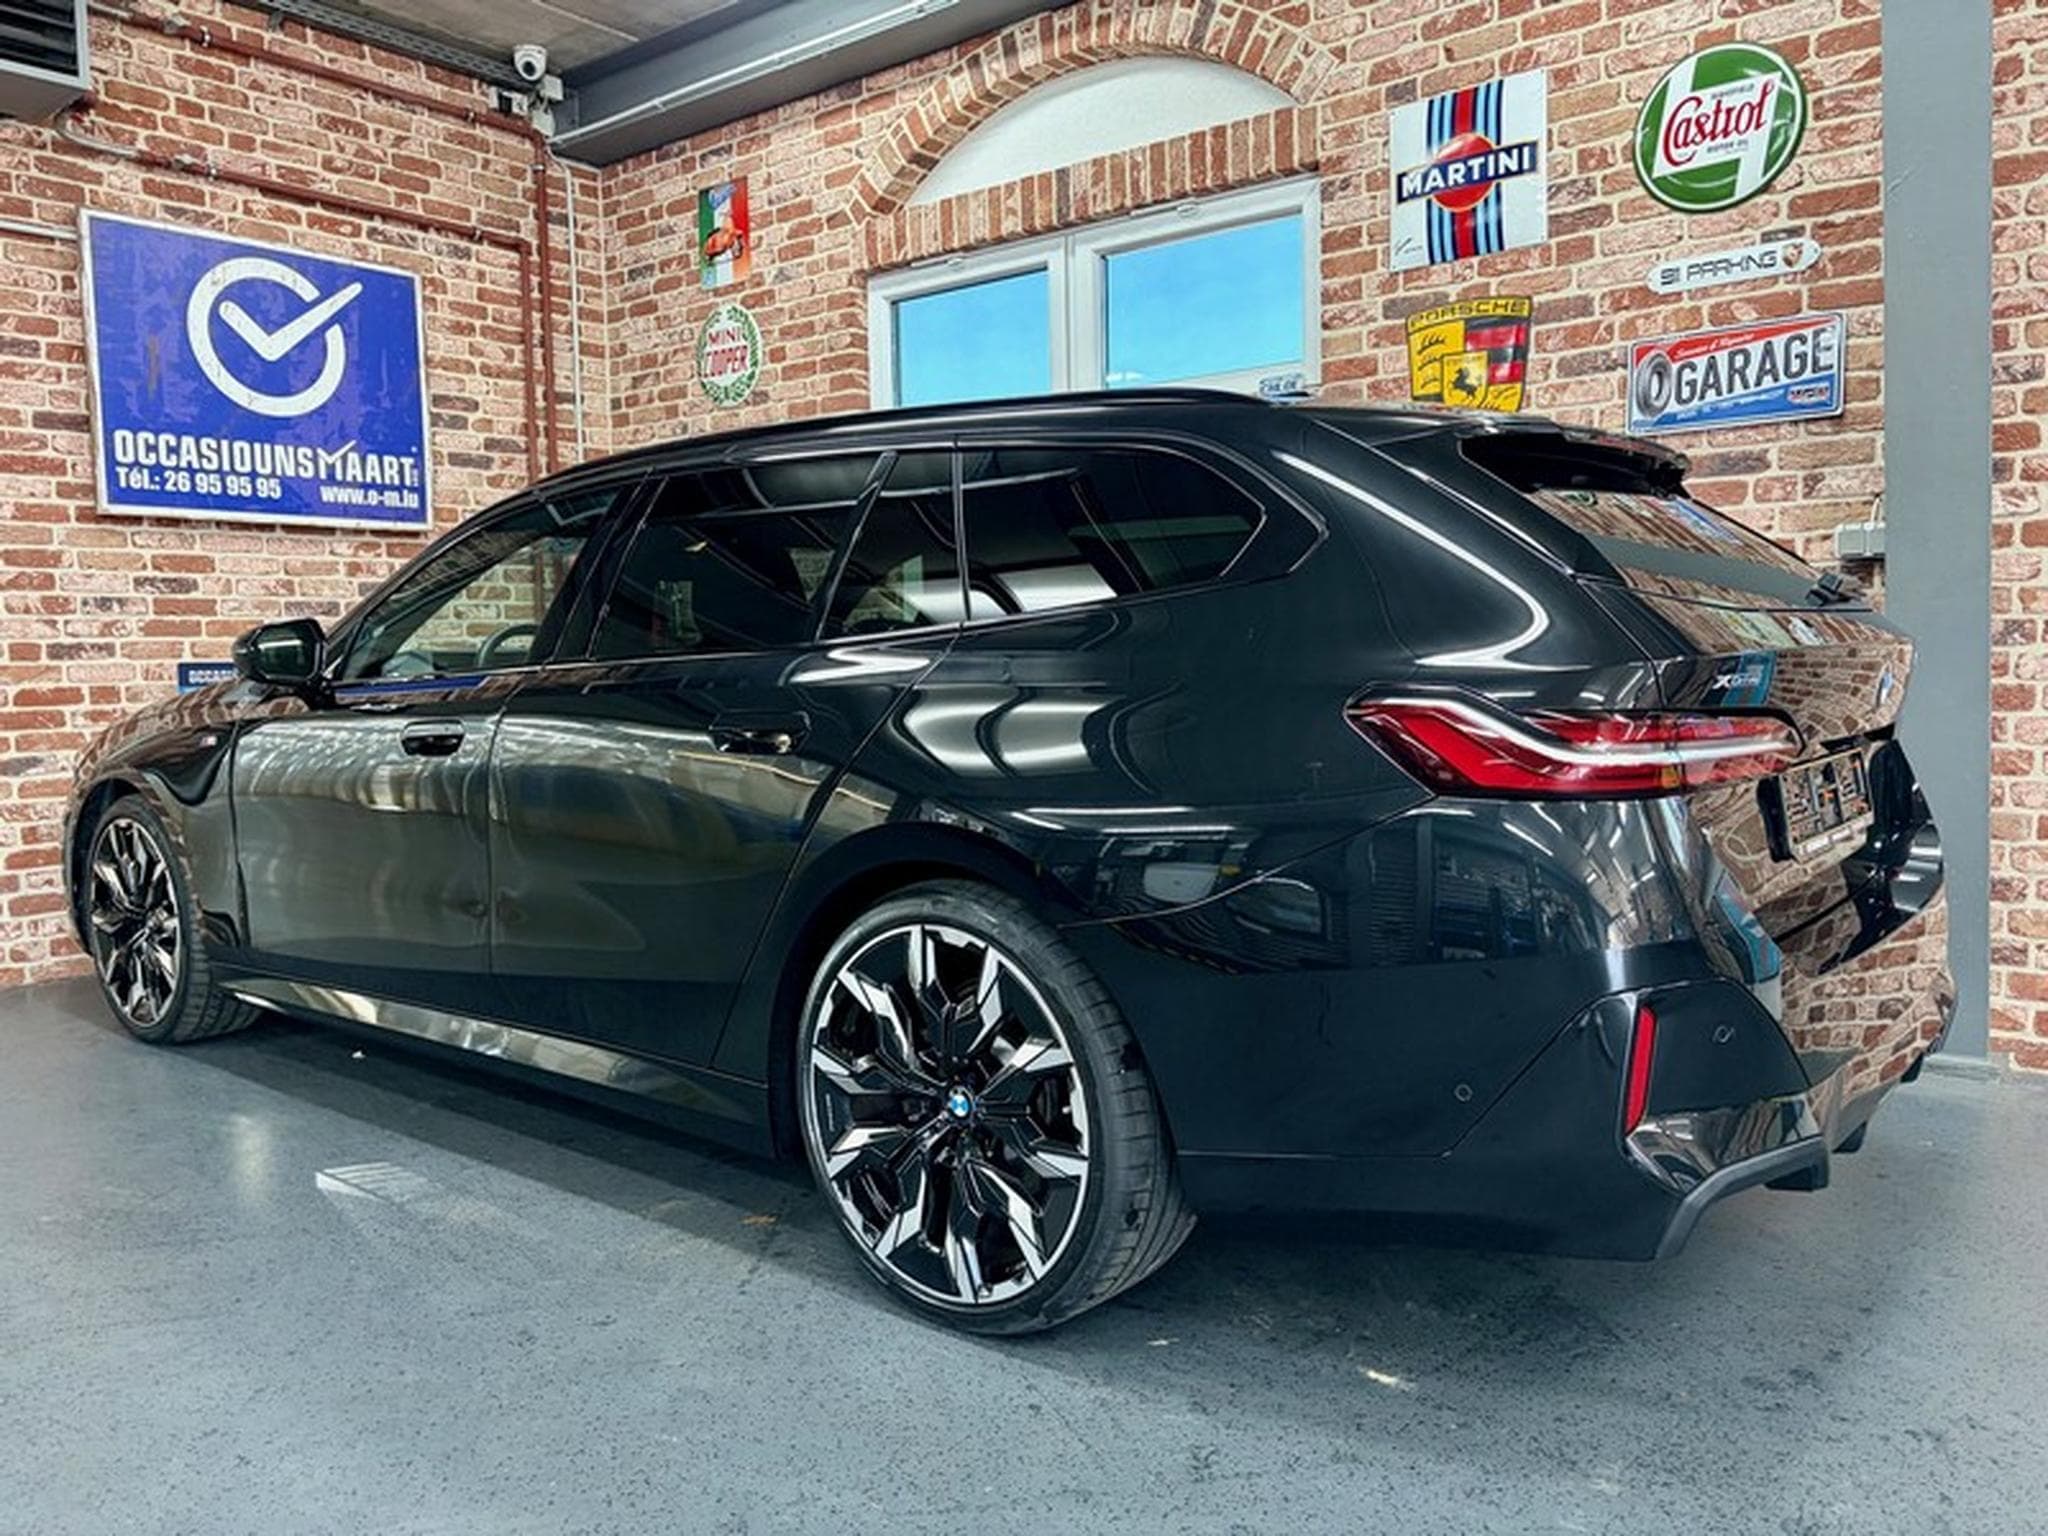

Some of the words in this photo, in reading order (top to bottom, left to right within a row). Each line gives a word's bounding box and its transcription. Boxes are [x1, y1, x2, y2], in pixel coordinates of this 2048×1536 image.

[1663, 79, 1775, 167] Castrol
[1401, 146, 1532, 199] MARTINI
[1686, 250, 1777, 281] PARKING
[1410, 300, 1526, 328] PORSCHE
[708, 326, 746, 344] MINI
[703, 345, 749, 378] COOPER
[1674, 326, 1836, 405] GARAGE
[115, 465, 161, 490] Tél.:
[163, 469, 192, 493] 26
[195, 471, 222, 495] 95
[226, 474, 252, 498] 95
[255, 477, 282, 500] 95
[319, 484, 419, 509] www.o-m.lu
